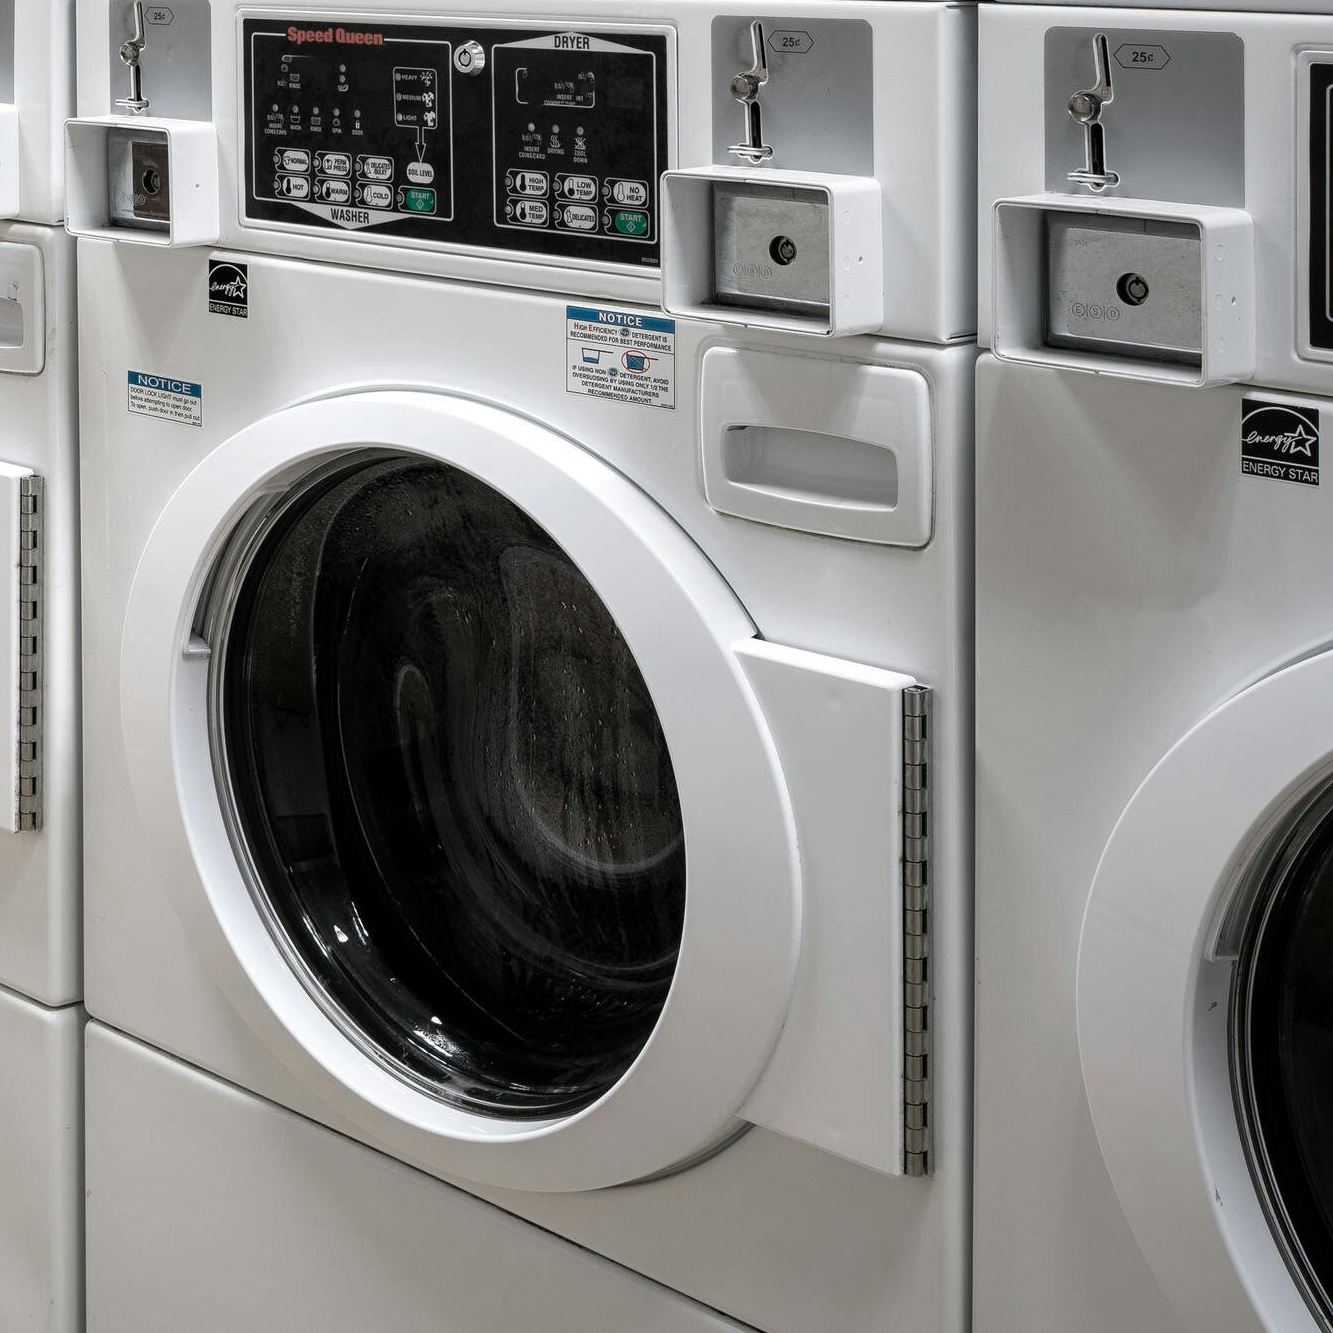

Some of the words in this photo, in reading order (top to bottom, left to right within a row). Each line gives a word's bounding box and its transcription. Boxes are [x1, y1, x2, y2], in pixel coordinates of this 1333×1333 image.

[154, 12, 166, 20] 25¢
[288, 26, 333, 44] Speed
[336, 28, 384, 45] Queen
[554, 35, 590, 49] DRYER
[782, 37, 800, 47] 25¢
[1133, 51, 1154, 62] 25¢
[291, 156, 308, 165] NORMAL
[330, 208, 370, 224] WASHER
[619, 214, 642, 222] START
[209, 303, 232, 314] ENERGY
[233, 306, 248, 316] STAR
[599, 312, 642, 326] NOTICE
[589, 324, 617, 335] EFFICIENCY
[632, 332, 661, 342] DETERGENT
[570, 331, 608, 342] RECOMMENDED
[634, 340, 671, 351] PERFORMANCE
[138, 374, 192, 394] NOTICE
[572, 372, 609, 383] OVERSUDSING
[582, 380, 612, 391] DETERGENT
[613, 385, 659, 398] MANUFACTURERS
[588, 389, 628, 400] RECOMMENDED
[144, 398, 165, 407] attempting
[1246, 430, 1292, 452] energy
[1243, 460, 1286, 477] ENERGY
[1288, 468, 1318, 482] STAR
